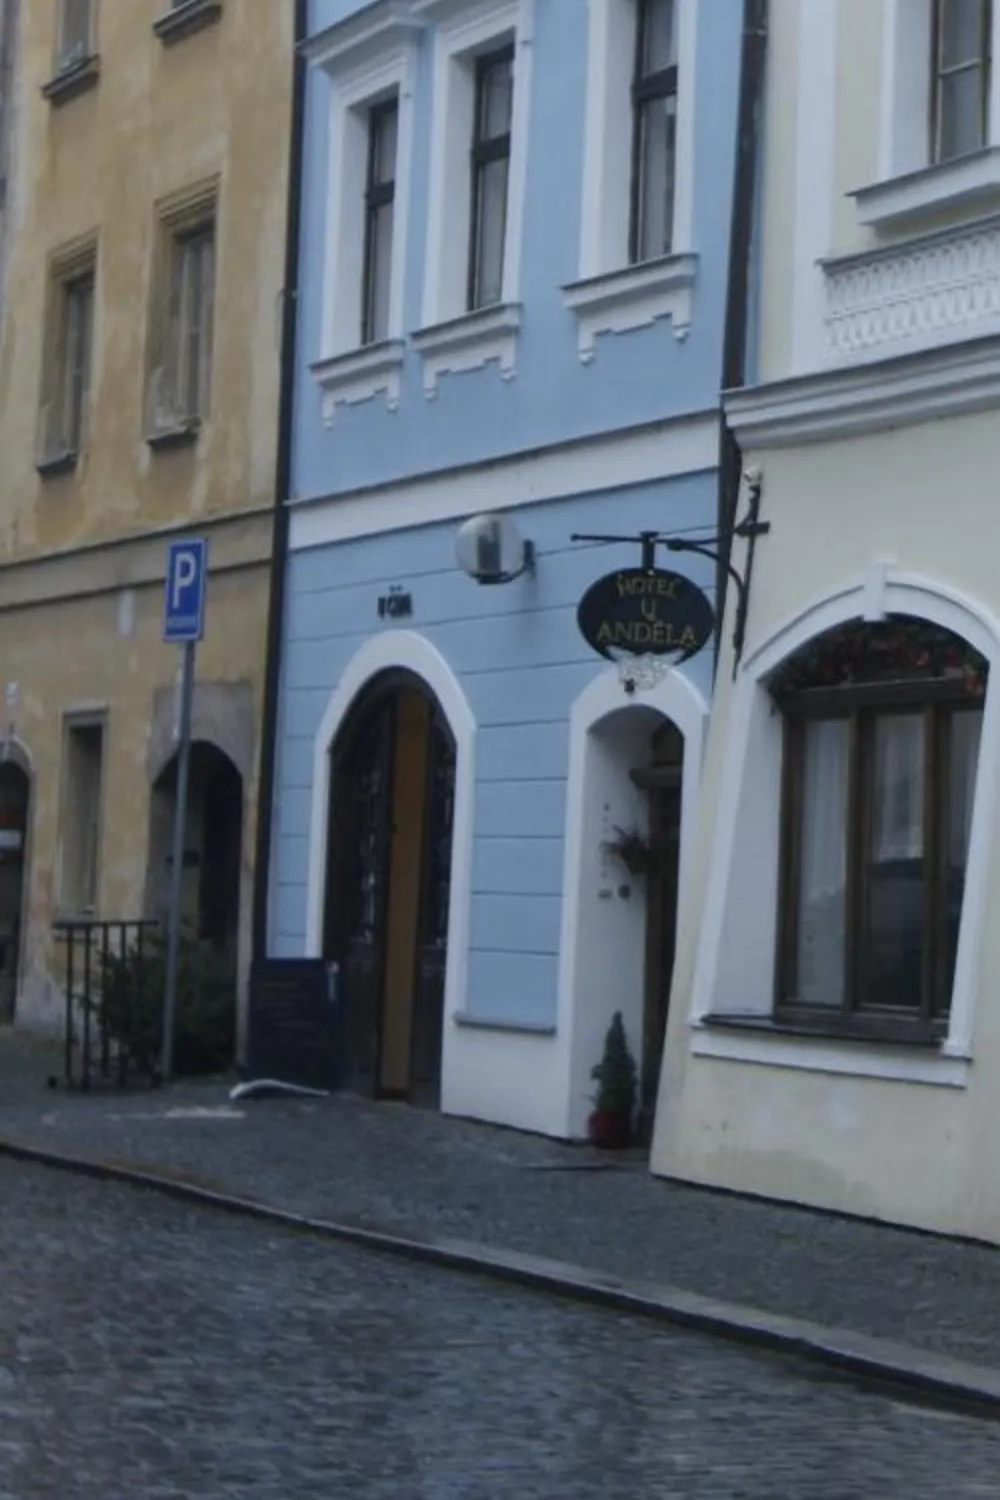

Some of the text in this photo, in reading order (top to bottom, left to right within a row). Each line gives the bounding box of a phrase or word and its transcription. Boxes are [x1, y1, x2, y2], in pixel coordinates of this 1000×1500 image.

[172, 552, 196, 610] P
[616, 575, 681, 598] HOTEL
[641, 598, 657, 621] U
